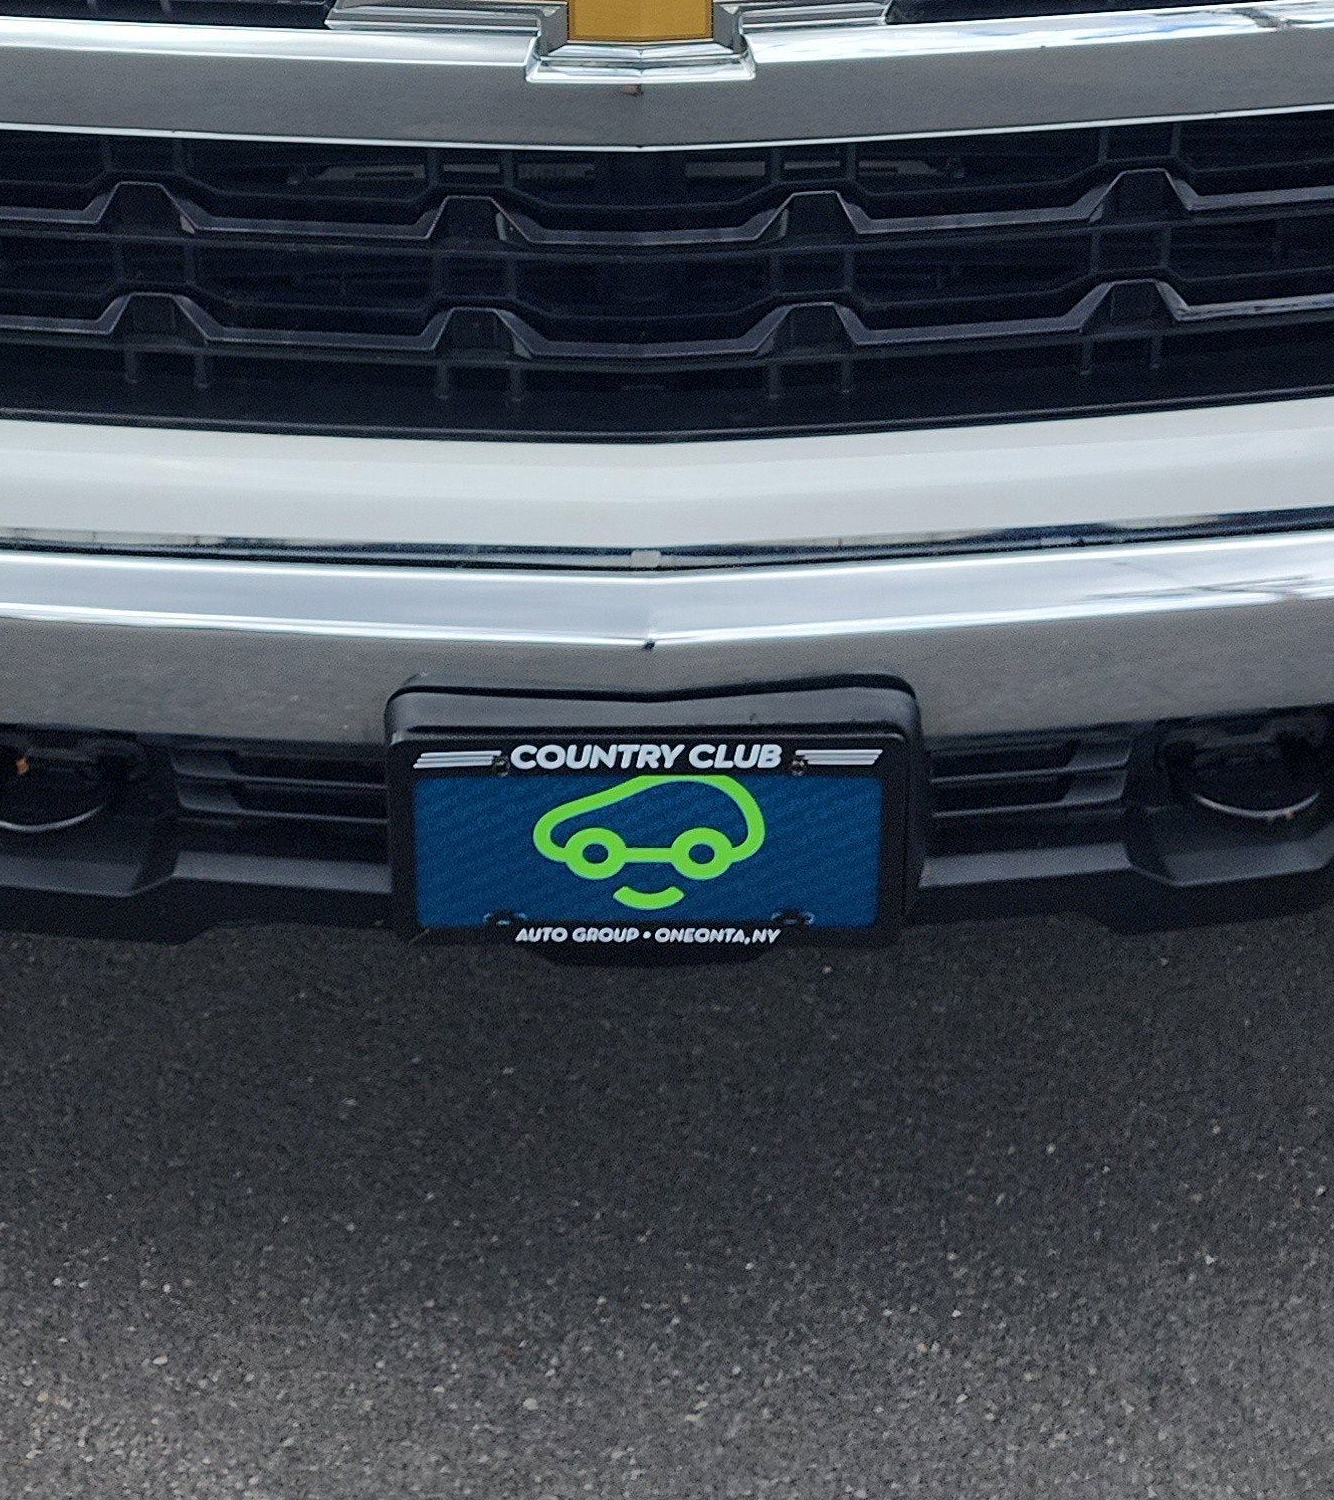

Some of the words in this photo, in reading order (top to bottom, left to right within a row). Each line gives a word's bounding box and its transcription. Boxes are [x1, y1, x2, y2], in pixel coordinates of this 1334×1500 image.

[510, 743, 685, 769] COUNTRY
[688, 743, 782, 769] CLUB
[515, 927, 568, 943] AUTO
[571, 927, 640, 943] GROUP
